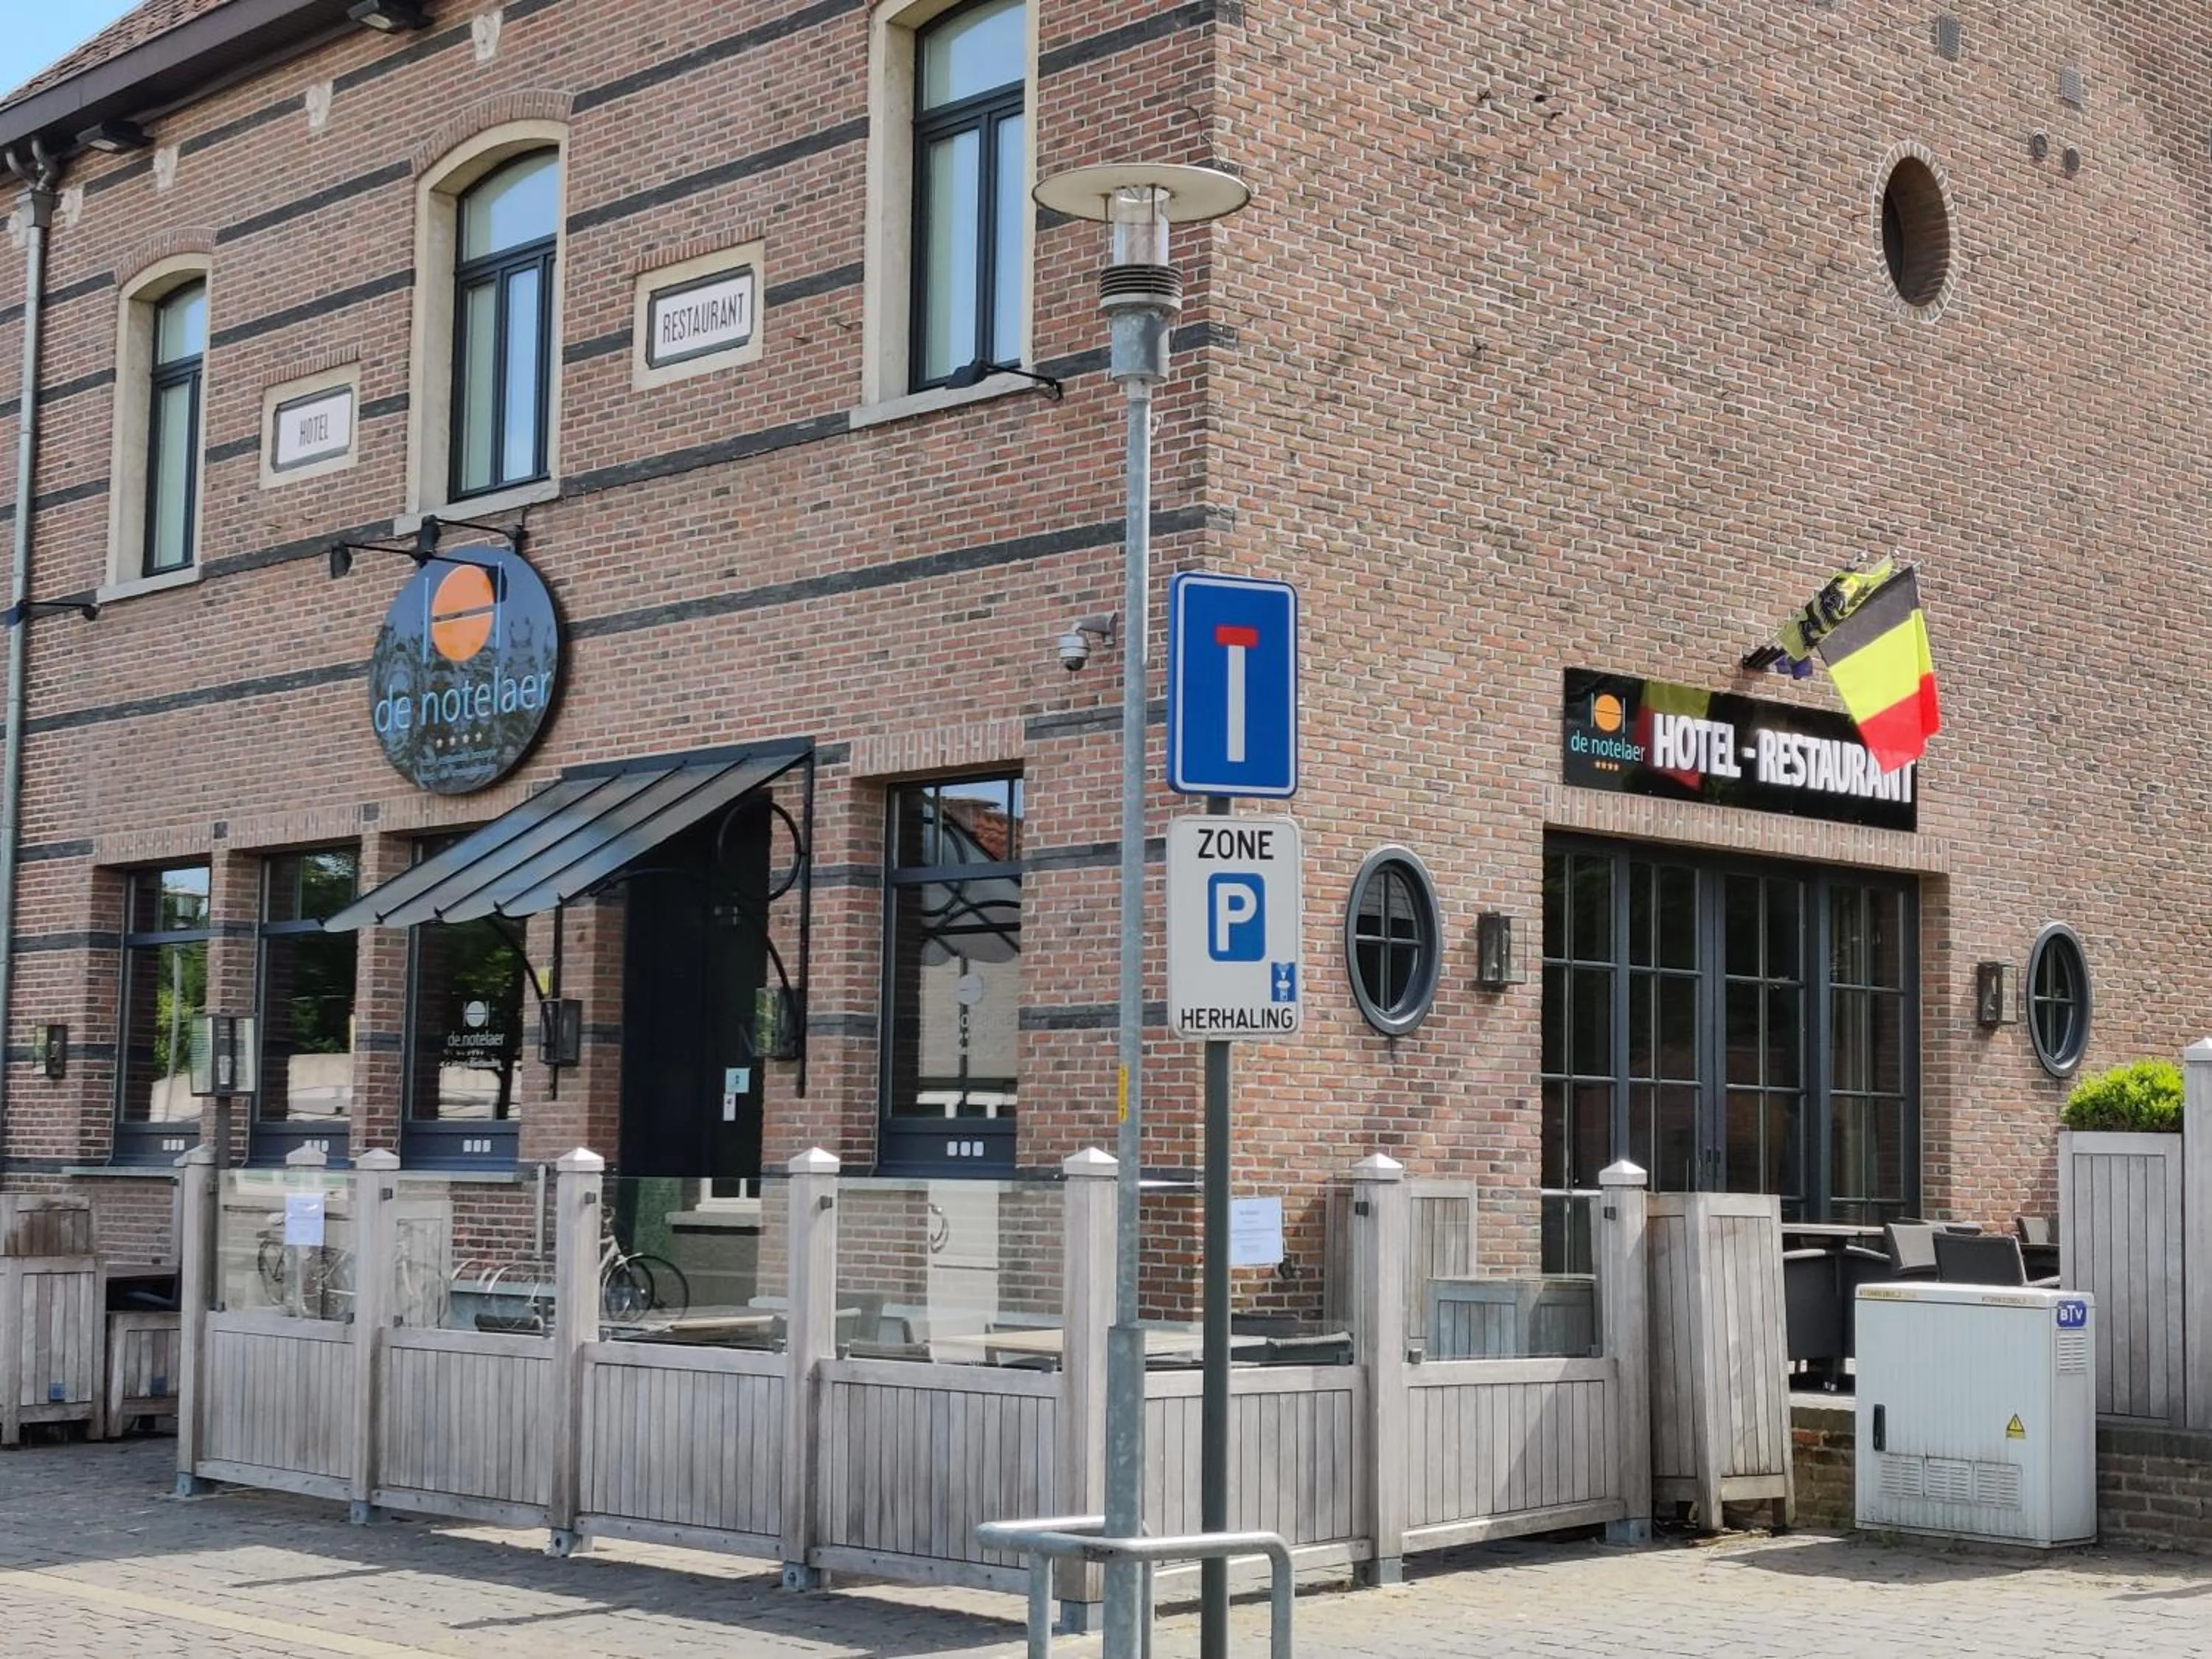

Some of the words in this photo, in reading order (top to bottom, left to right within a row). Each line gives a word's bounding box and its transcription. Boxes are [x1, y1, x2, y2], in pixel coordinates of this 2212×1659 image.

[663, 293, 743, 344] RESTAURANT
[299, 413, 328, 447] HOTEL
[375, 684, 412, 732] de
[420, 666, 551, 726] notelaer
[1571, 729, 1588, 753] de
[1592, 737, 1646, 762] notelaer
[1197, 829, 1275, 860] ZONE
[1217, 883, 1256, 951] P
[1181, 1008, 1293, 1029] HERHALING
